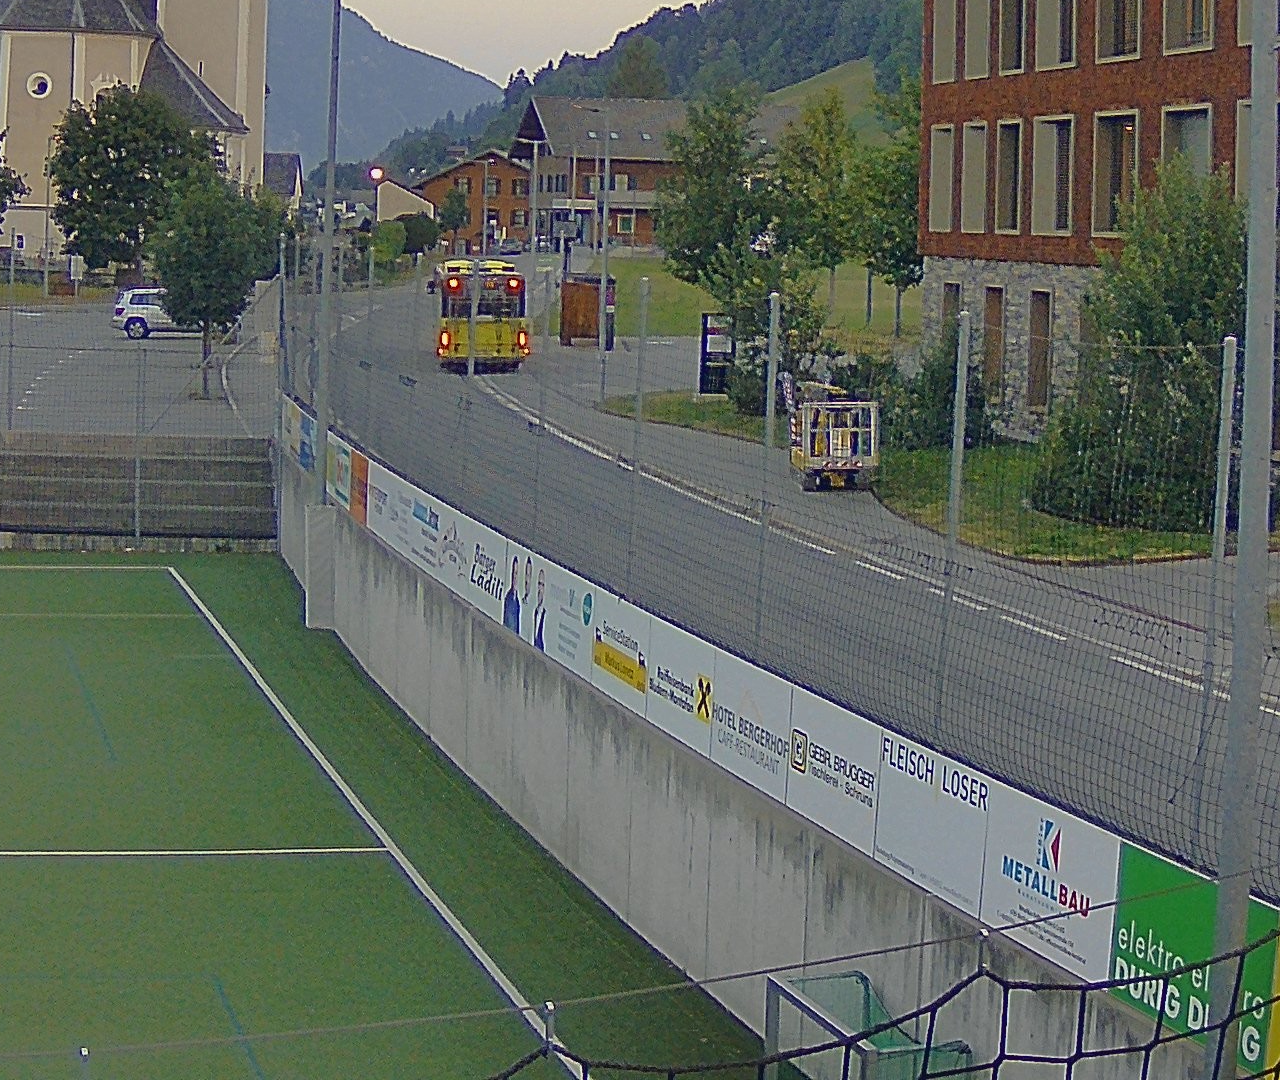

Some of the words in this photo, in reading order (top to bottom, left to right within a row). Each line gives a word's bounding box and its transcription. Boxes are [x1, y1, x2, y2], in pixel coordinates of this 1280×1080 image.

[712, 701, 737, 731] HOTEL
[808, 741, 832, 769] GEBR.
[833, 754, 875, 792] BRUGGER
[881, 737, 935, 786] FLEISCH
[942, 764, 989, 812] LOSER
[844, 780, 873, 809] Schruns
[1002, 855, 1091, 918] METALLBAU
[1117, 920, 1186, 979] elektro
